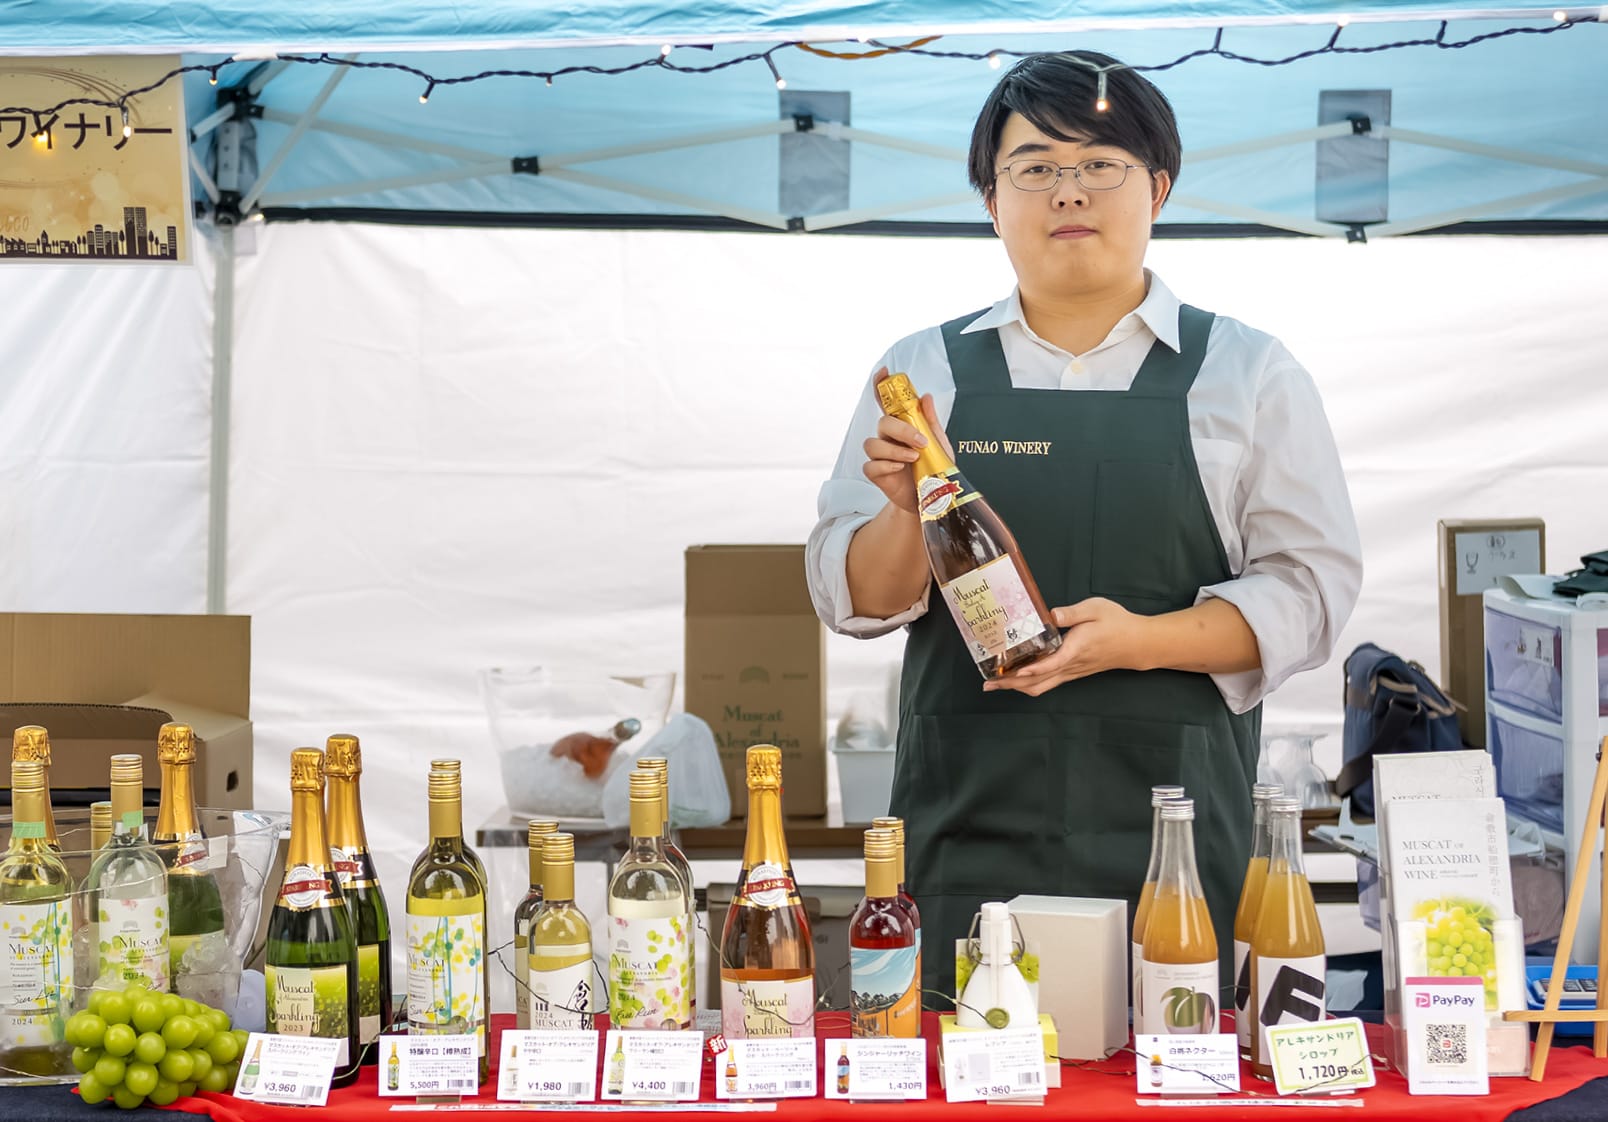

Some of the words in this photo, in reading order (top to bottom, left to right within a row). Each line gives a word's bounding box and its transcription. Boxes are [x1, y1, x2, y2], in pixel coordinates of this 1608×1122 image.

[957, 440, 999, 454] FUNAO
[1003, 440, 1053, 456] WINERY
[952, 578, 990, 605] Muscat
[978, 620, 998, 633] 2024
[723, 705, 784, 722] Muscat
[1402, 840, 1452, 850] MUSCAT
[1403, 854, 1481, 865] ALEXANDRIA
[1404, 870, 1438, 880] WINE
[276, 974, 315, 994] Muscat
[742, 989, 788, 1008] Muscat
[1432, 994, 1475, 1008] PayPay
[11, 1017, 33, 1025] 2024
[270, 1000, 321, 1033] Sparkling
[283, 1023, 304, 1032] 2023
[535, 1019, 574, 1028] MUSCAT
[743, 1015, 792, 1039] Sparkling
[709, 1035, 727, 1054] 新
[1276, 1031, 1355, 1048] アレキサンドリア
[1169, 1047, 1216, 1055] 白桃ネクター
[1299, 1047, 1339, 1060] シロップ
[1298, 1064, 1349, 1081] 1,720円
[264, 1082, 297, 1093] ¥3,960
[410, 1081, 440, 1089] 5,500円
[527, 1081, 562, 1091] ¥1,980
[632, 1081, 666, 1090] ¥4,400
[747, 1082, 777, 1091] 3,960円
[888, 1081, 922, 1090] 1,430円
[975, 1084, 1011, 1096] ¥3,960
